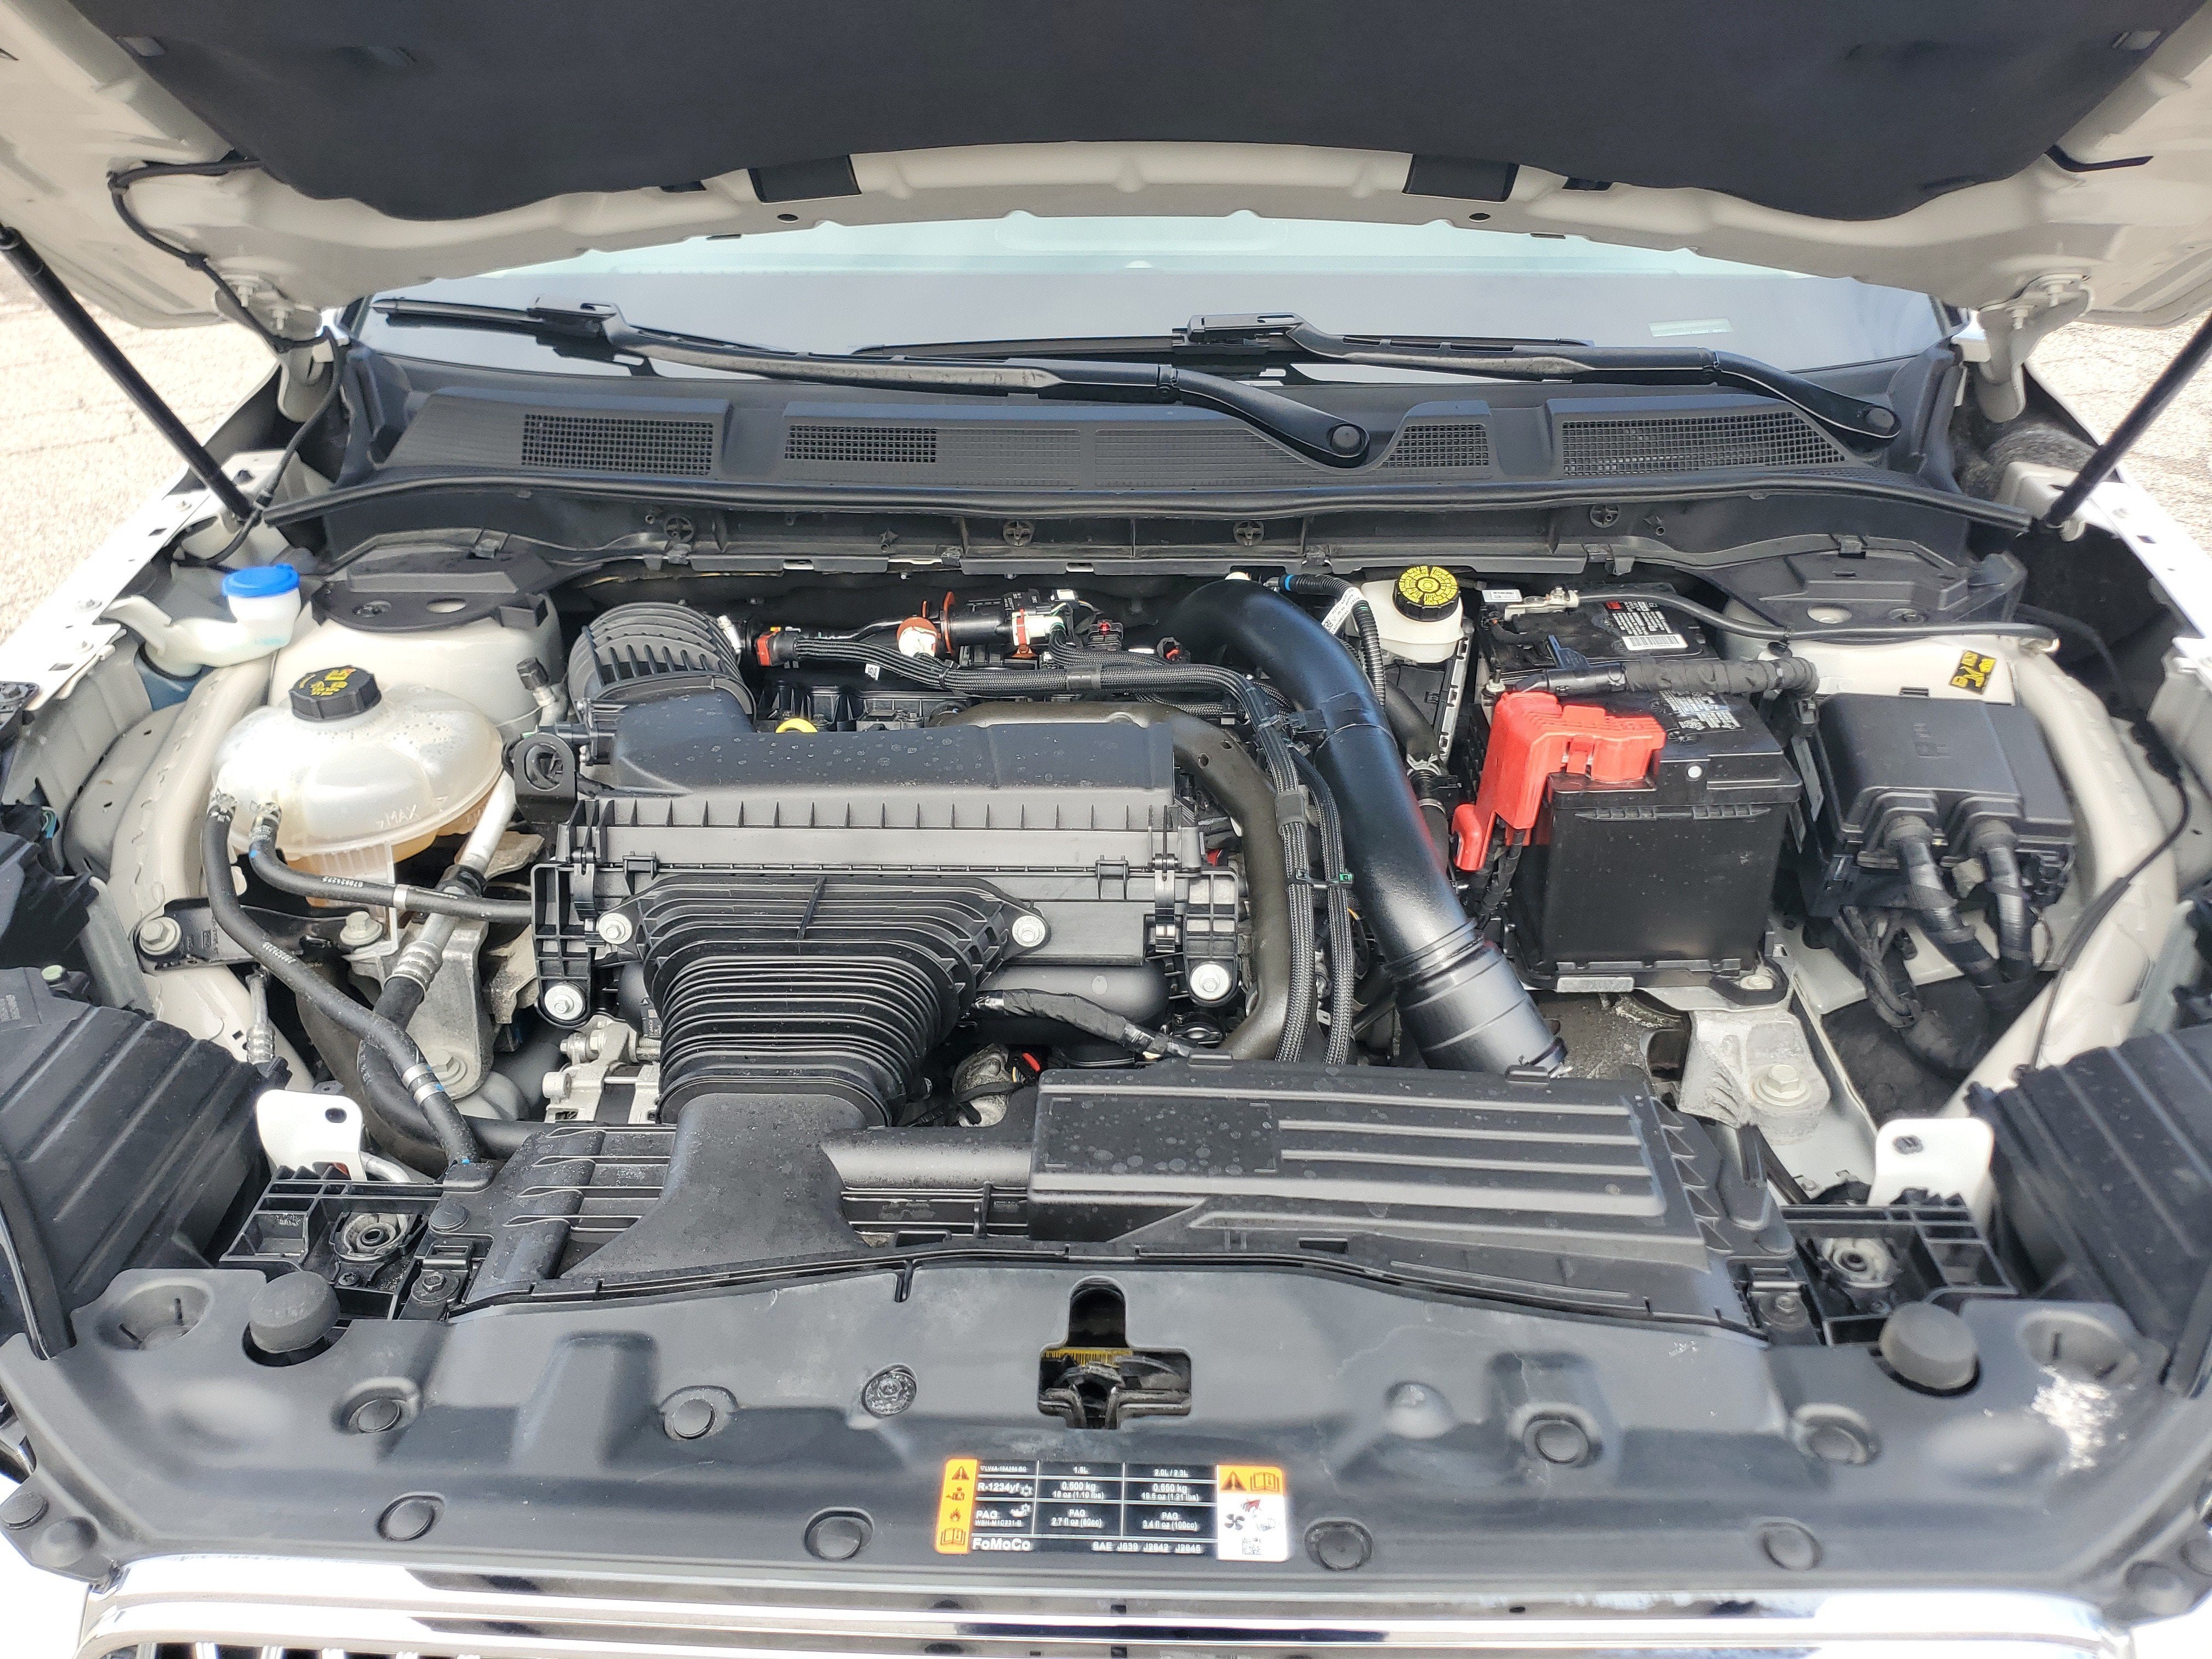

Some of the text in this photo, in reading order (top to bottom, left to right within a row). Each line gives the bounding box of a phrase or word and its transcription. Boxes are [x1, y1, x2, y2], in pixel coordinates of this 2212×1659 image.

[1073, 1466, 1088, 1474] 1.5L
[978, 1482, 1019, 1493] R-1234yf
[1062, 1481, 1097, 1491] 0.500 kg
[1177, 1483, 1188, 1493] kg
[1073, 1491, 1090, 1499] (1.10
[1091, 1491, 1104, 1499] lbs)
[1186, 1493, 1199, 1502] lbs)
[976, 1510, 998, 1519] PAG
[1069, 1509, 1086, 1517] PAG
[1161, 1511, 1178, 1520] PAG
[1052, 1517, 1062, 1525] 2.7
[1142, 1520, 1153, 1528] 3.4
[1155, 1521, 1160, 1529] fl
[1171, 1521, 1198, 1531] (100cc)
[972, 1538, 1031, 1550] FoMoCo
[1092, 1542, 1113, 1550] SAE
[1117, 1542, 1138, 1550] J639
